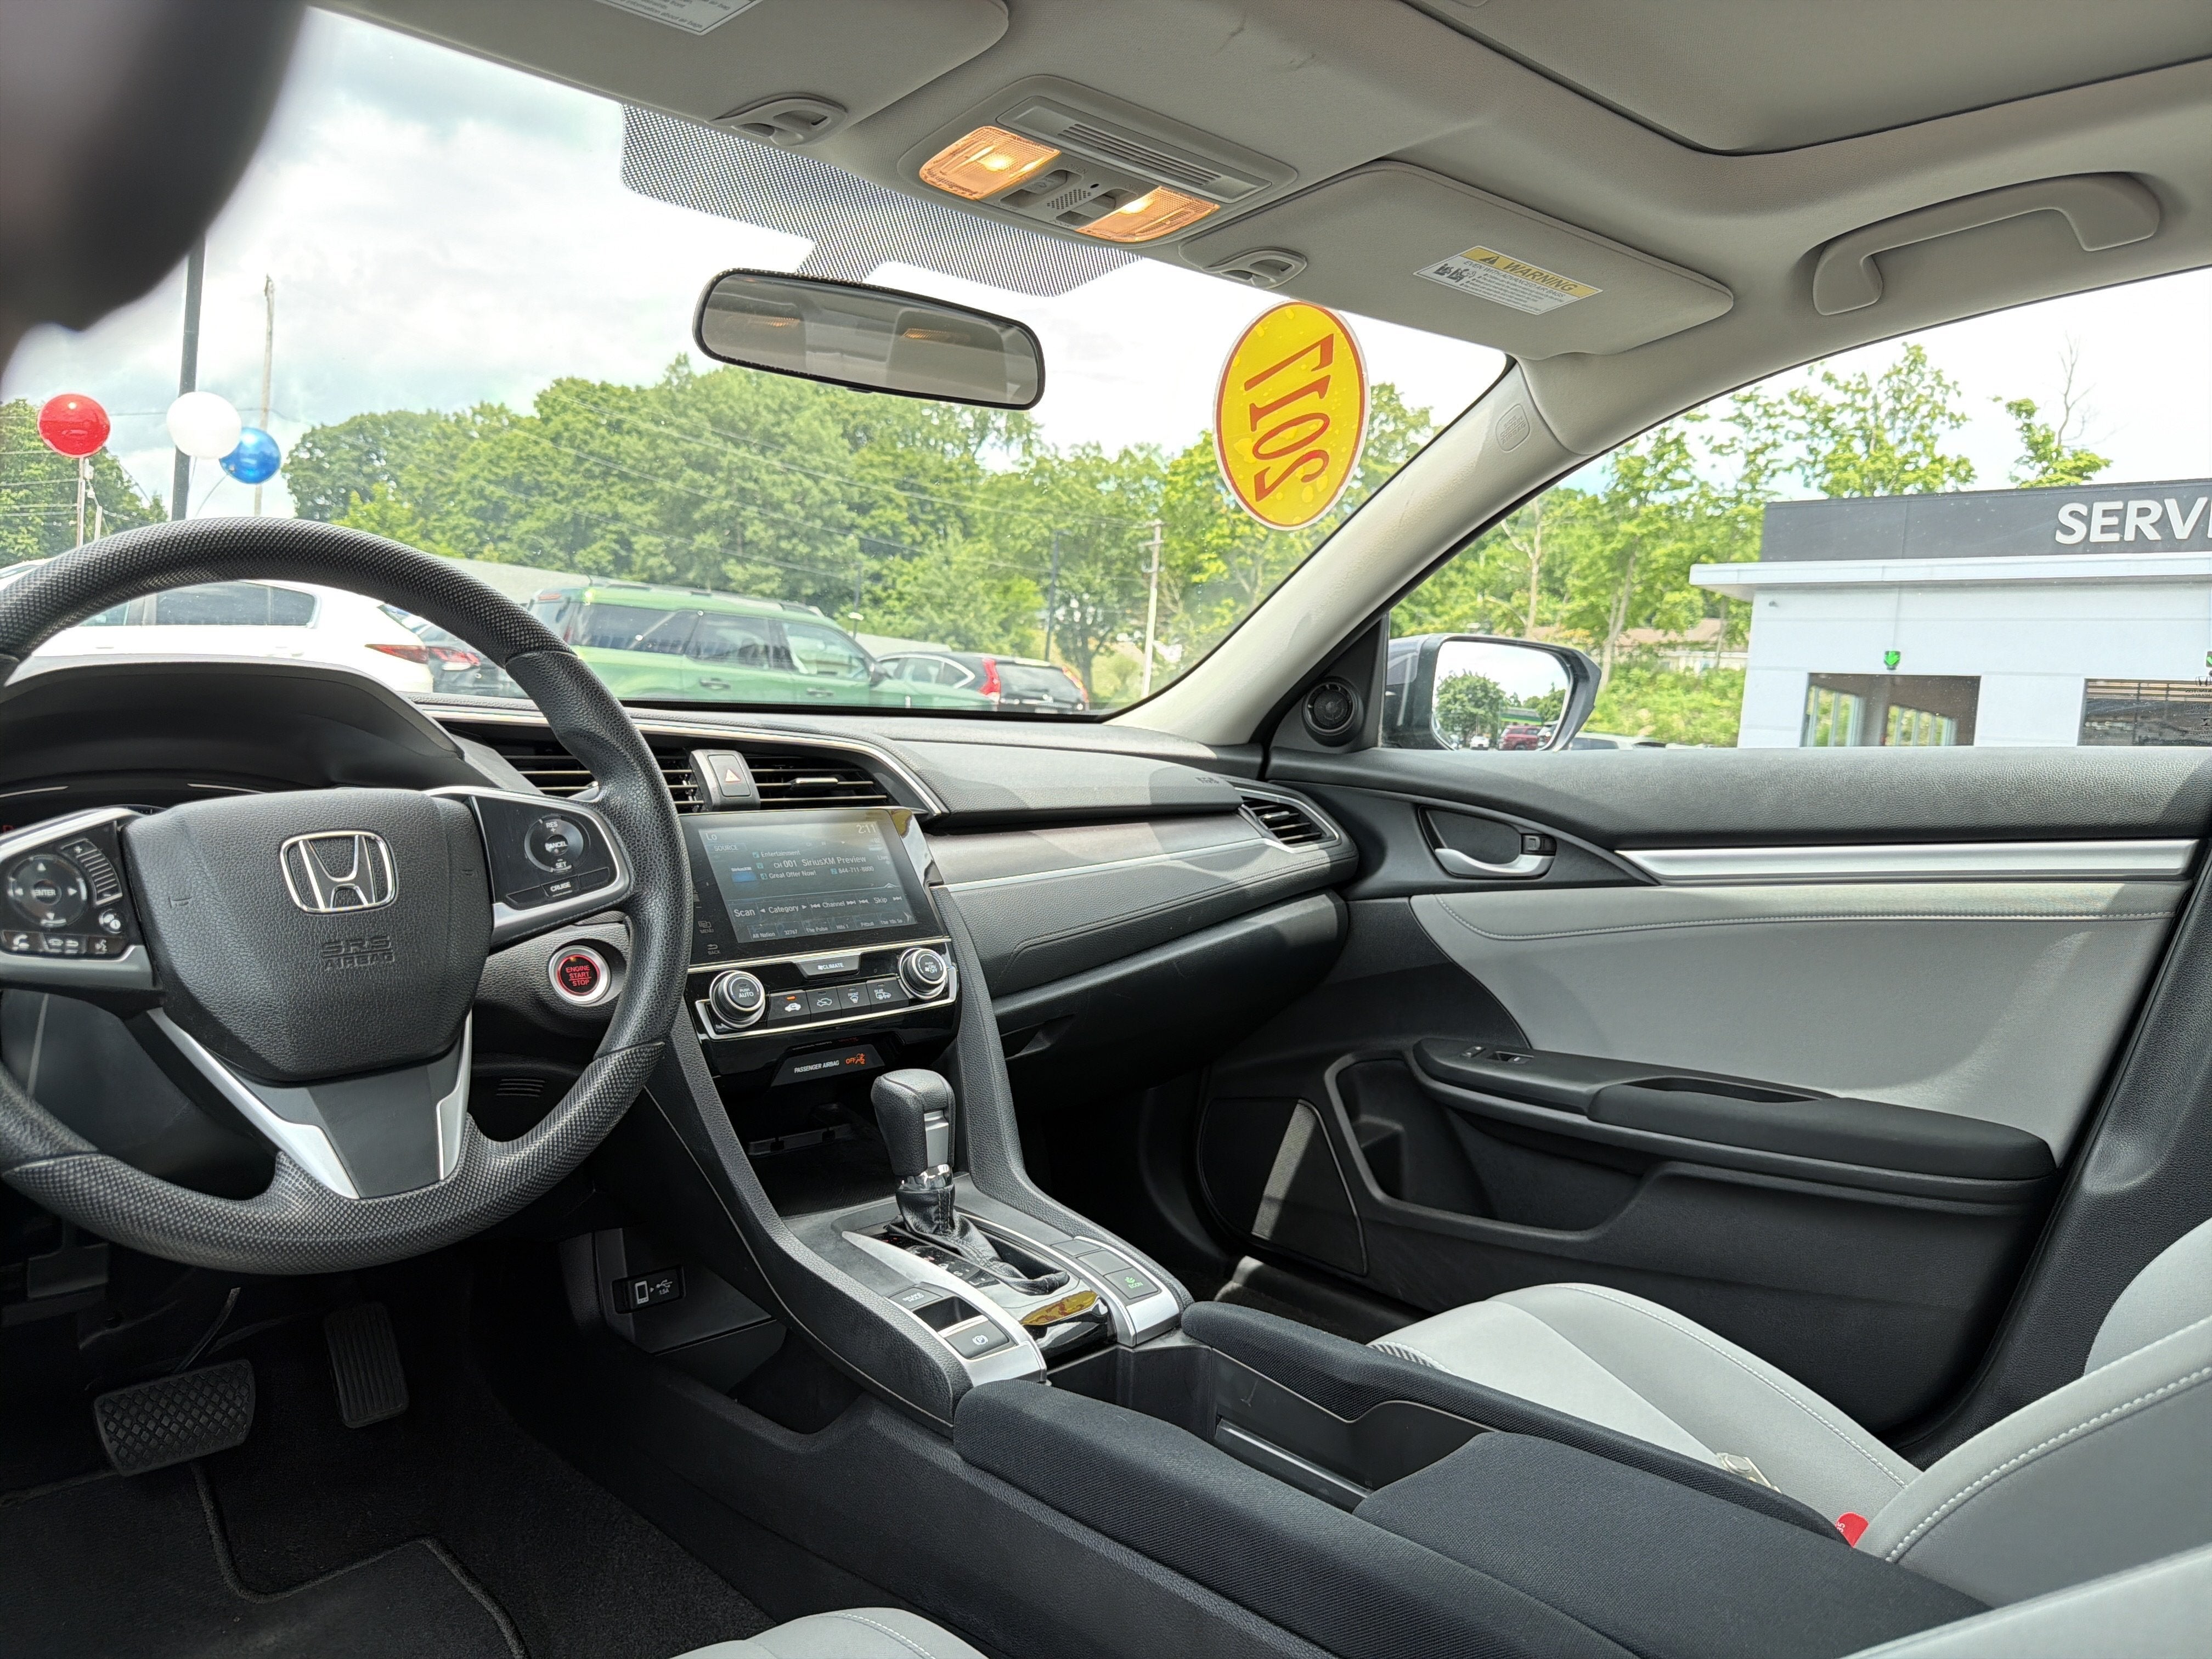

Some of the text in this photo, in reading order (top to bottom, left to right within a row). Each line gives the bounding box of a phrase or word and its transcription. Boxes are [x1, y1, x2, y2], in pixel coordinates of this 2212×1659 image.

[660, 12, 680, 20] about
[1464, 261, 1483, 270] EVEN
[1483, 267, 1503, 276] WITH
[1500, 274, 1537, 288] ADVANCED
[1503, 262, 1578, 292] WARNING
[2055, 495, 2212, 545] SERV
[546, 821, 558, 829] RES
[706, 824, 877, 842] Lo 2:11
[545, 840, 568, 849] CANCEL
[555, 861, 567, 870] SET
[783, 860, 798, 868] 001
[801, 857, 836, 867] SiriusXM
[837, 855, 867, 864] Preview
[550, 881, 572, 893] CRUISE
[733, 909, 755, 917] Scan
[768, 905, 799, 914] Category
[873, 896, 888, 905] Skip
[822, 961, 845, 969] CLIMATE
[572, 979, 590, 987] STOP
[738, 990, 755, 998] AUTO
[794, 1063, 822, 1074] PASSENGER
[822, 1060, 840, 1069] AIRBAG
